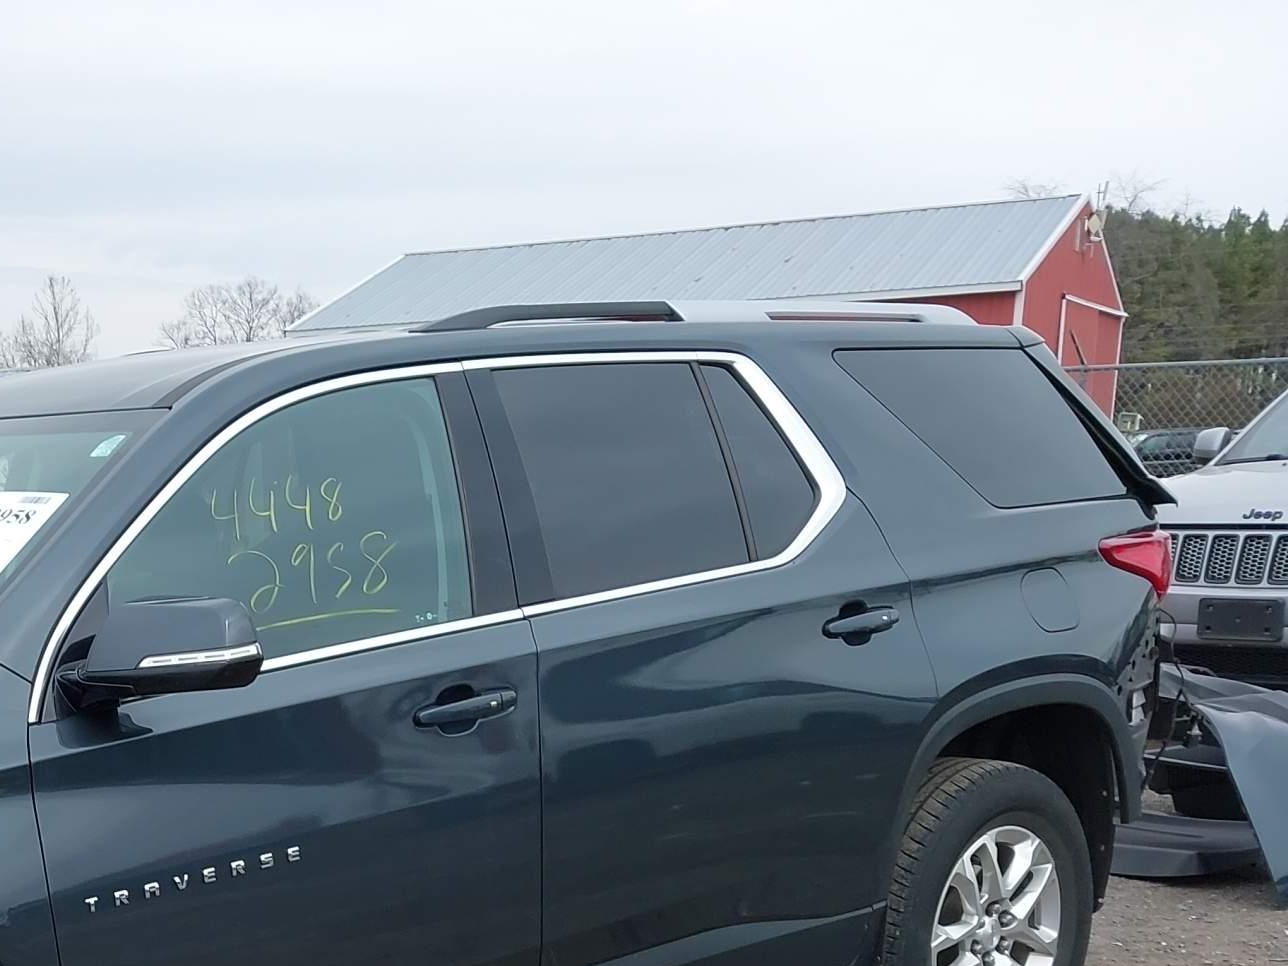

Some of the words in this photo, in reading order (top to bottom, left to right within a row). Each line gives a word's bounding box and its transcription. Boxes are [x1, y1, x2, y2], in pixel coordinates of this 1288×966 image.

[210, 474, 343, 540] 4448
[1242, 508, 1284, 521] Jeep
[227, 531, 398, 613] 2958
[83, 845, 302, 913] TRAVERSE
